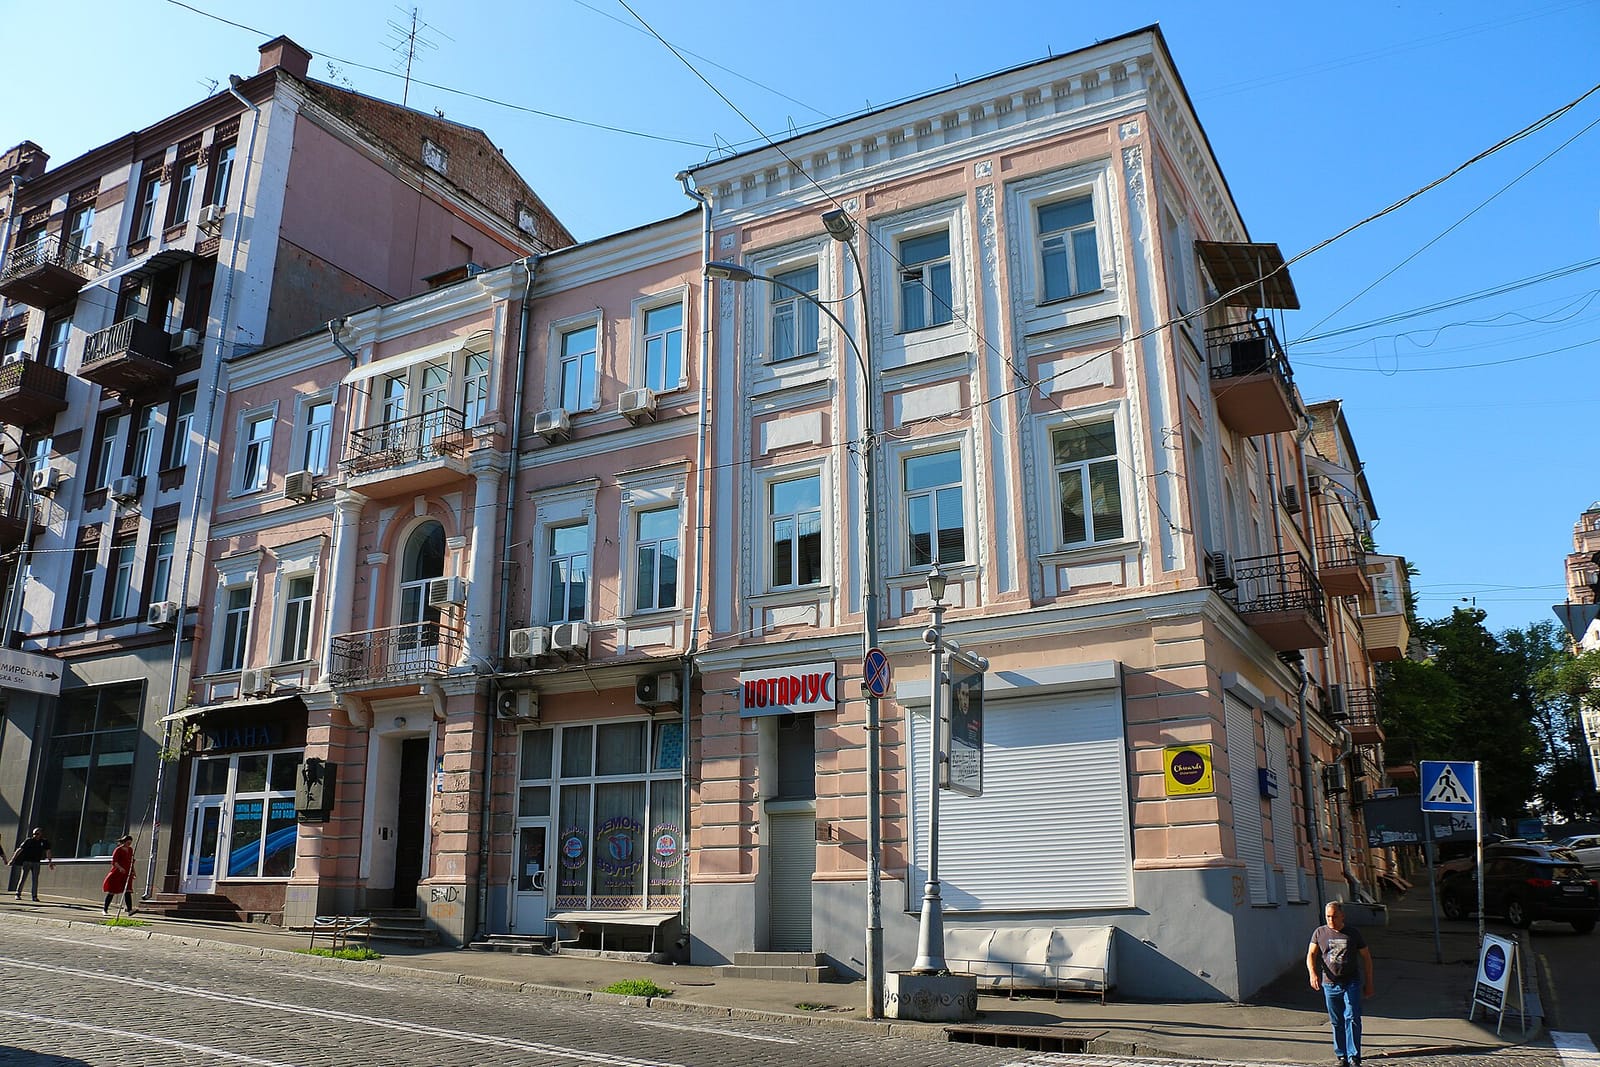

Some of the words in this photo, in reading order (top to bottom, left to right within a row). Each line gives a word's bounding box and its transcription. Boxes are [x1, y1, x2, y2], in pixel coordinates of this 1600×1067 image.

[0, 663, 44, 678] МИРСЬКА
[13, 676, 25, 684] Str.
[744, 672, 834, 708] НОТАРІУС
[596, 816, 643, 841] РЕМОНТ
[596, 855, 643, 877] ВЗУТТЯ
